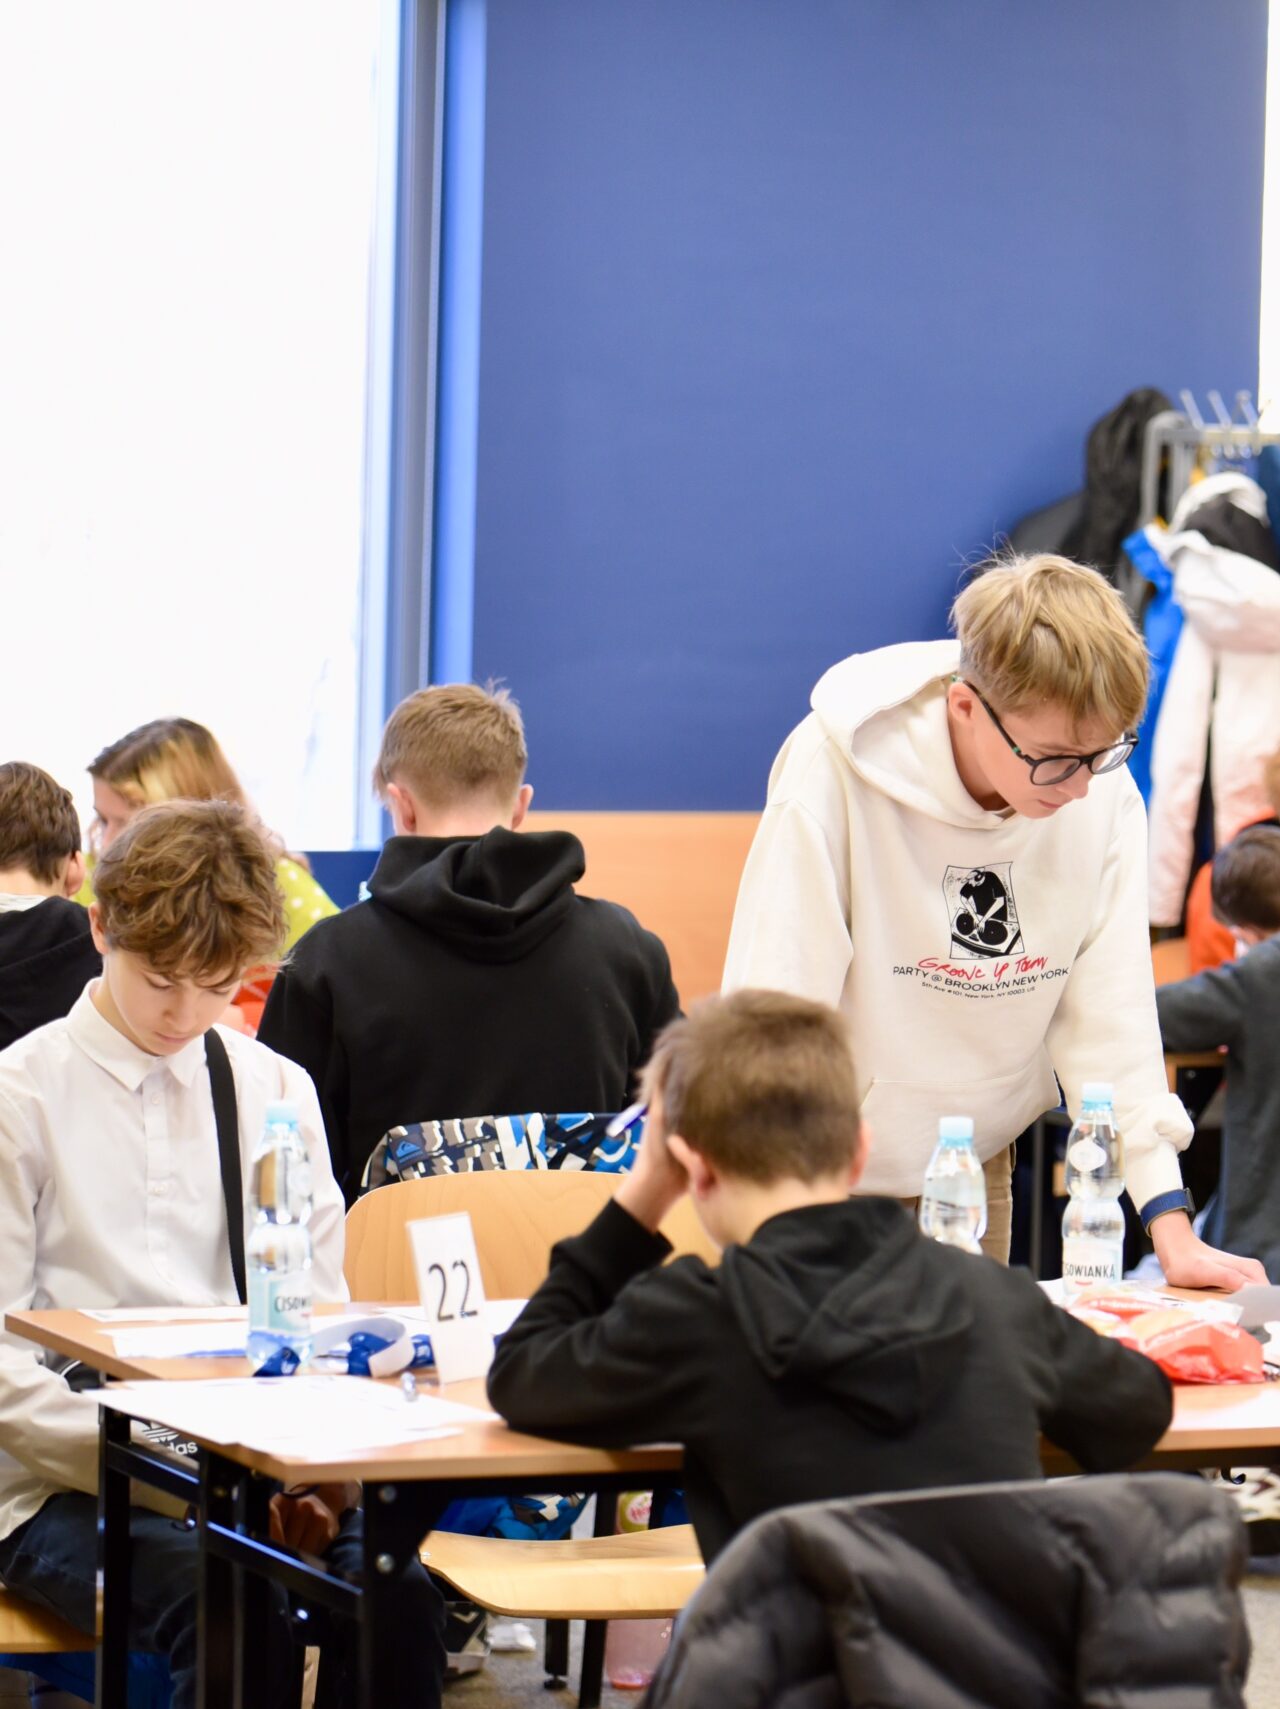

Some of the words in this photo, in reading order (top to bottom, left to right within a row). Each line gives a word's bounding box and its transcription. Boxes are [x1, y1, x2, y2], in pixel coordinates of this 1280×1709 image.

[893, 965, 928, 979] PARTY
[931, 973, 943, 982] @
[944, 978, 1010, 992] BROOKLYN
[1012, 974, 1039, 987] NEW
[1041, 967, 1070, 981] YORK
[428, 1260, 478, 1322] 22
